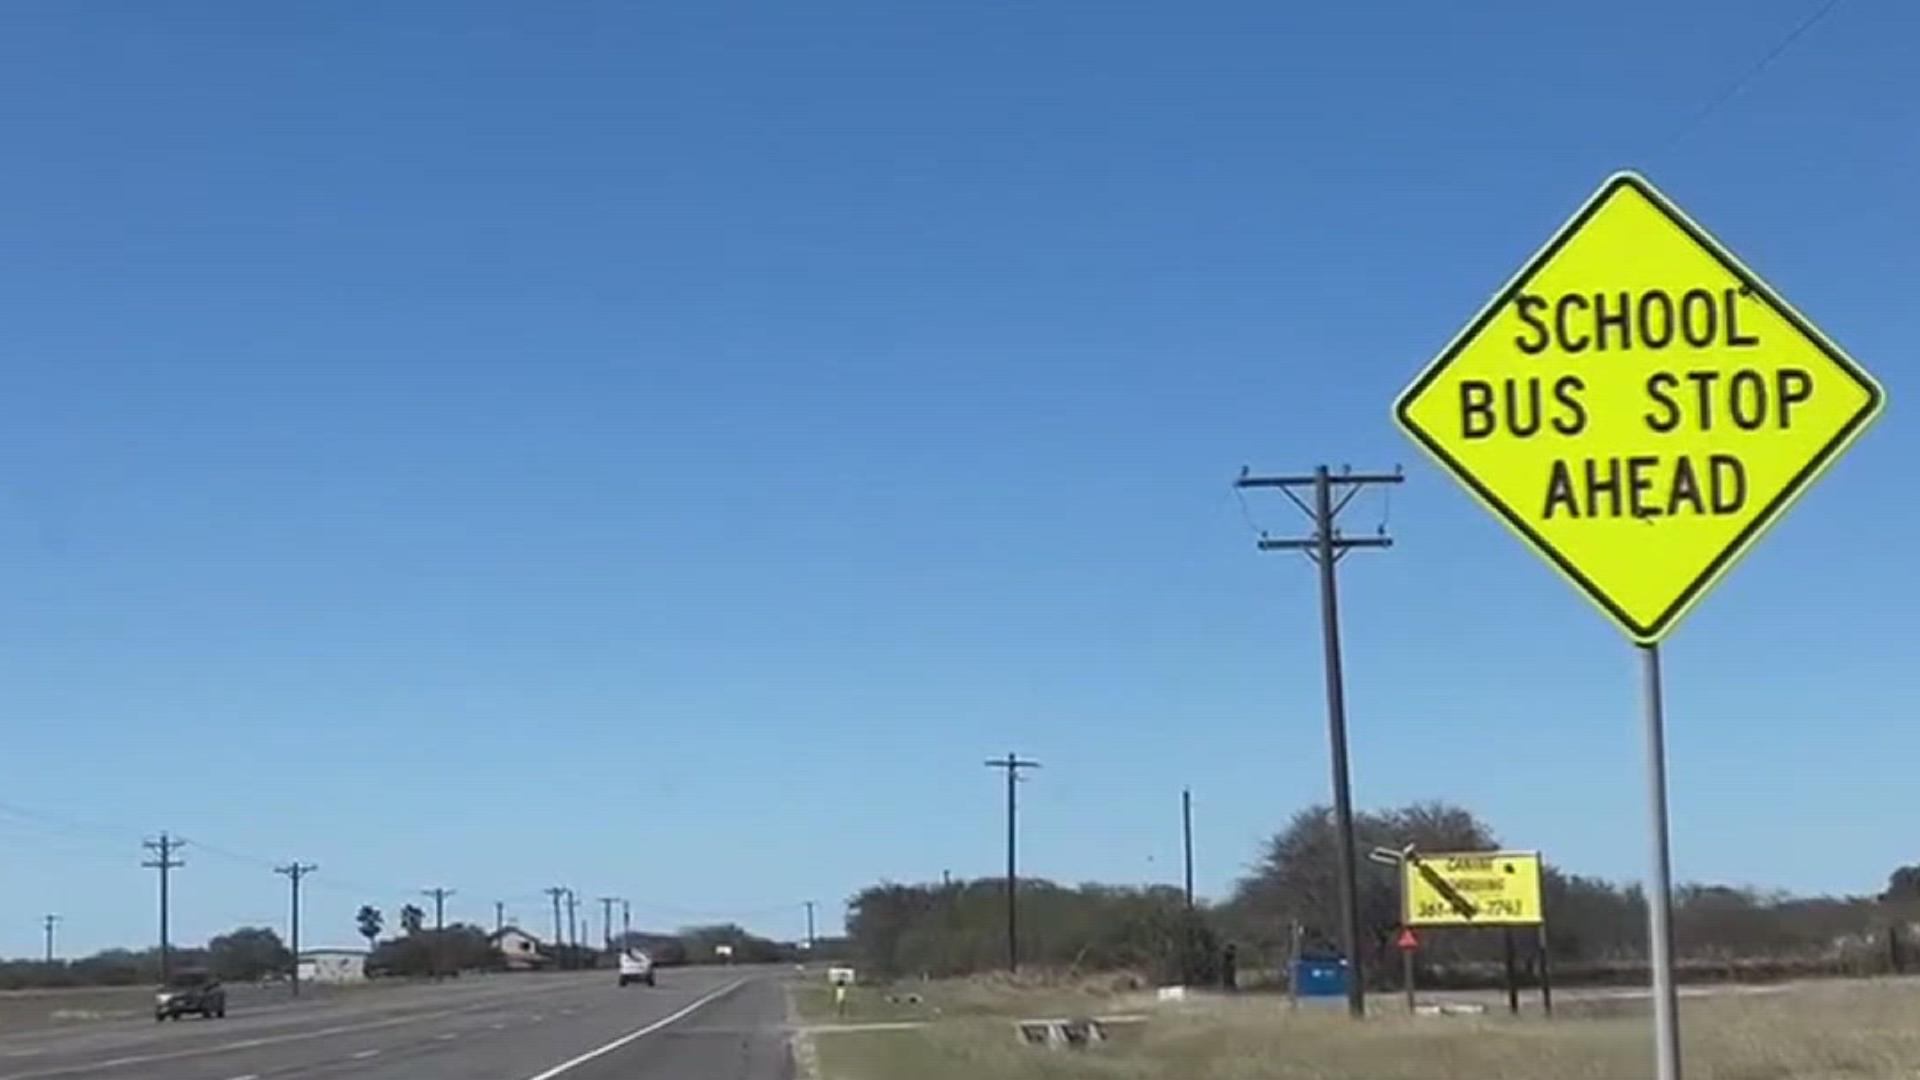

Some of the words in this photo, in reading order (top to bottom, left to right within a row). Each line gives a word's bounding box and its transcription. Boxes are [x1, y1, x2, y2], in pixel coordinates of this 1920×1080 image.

[1514, 287, 1760, 354] SCHOOL
[1459, 375, 1587, 439] BUS
[1644, 369, 1814, 433] STOP
[1542, 454, 1748, 519] AHEAD
